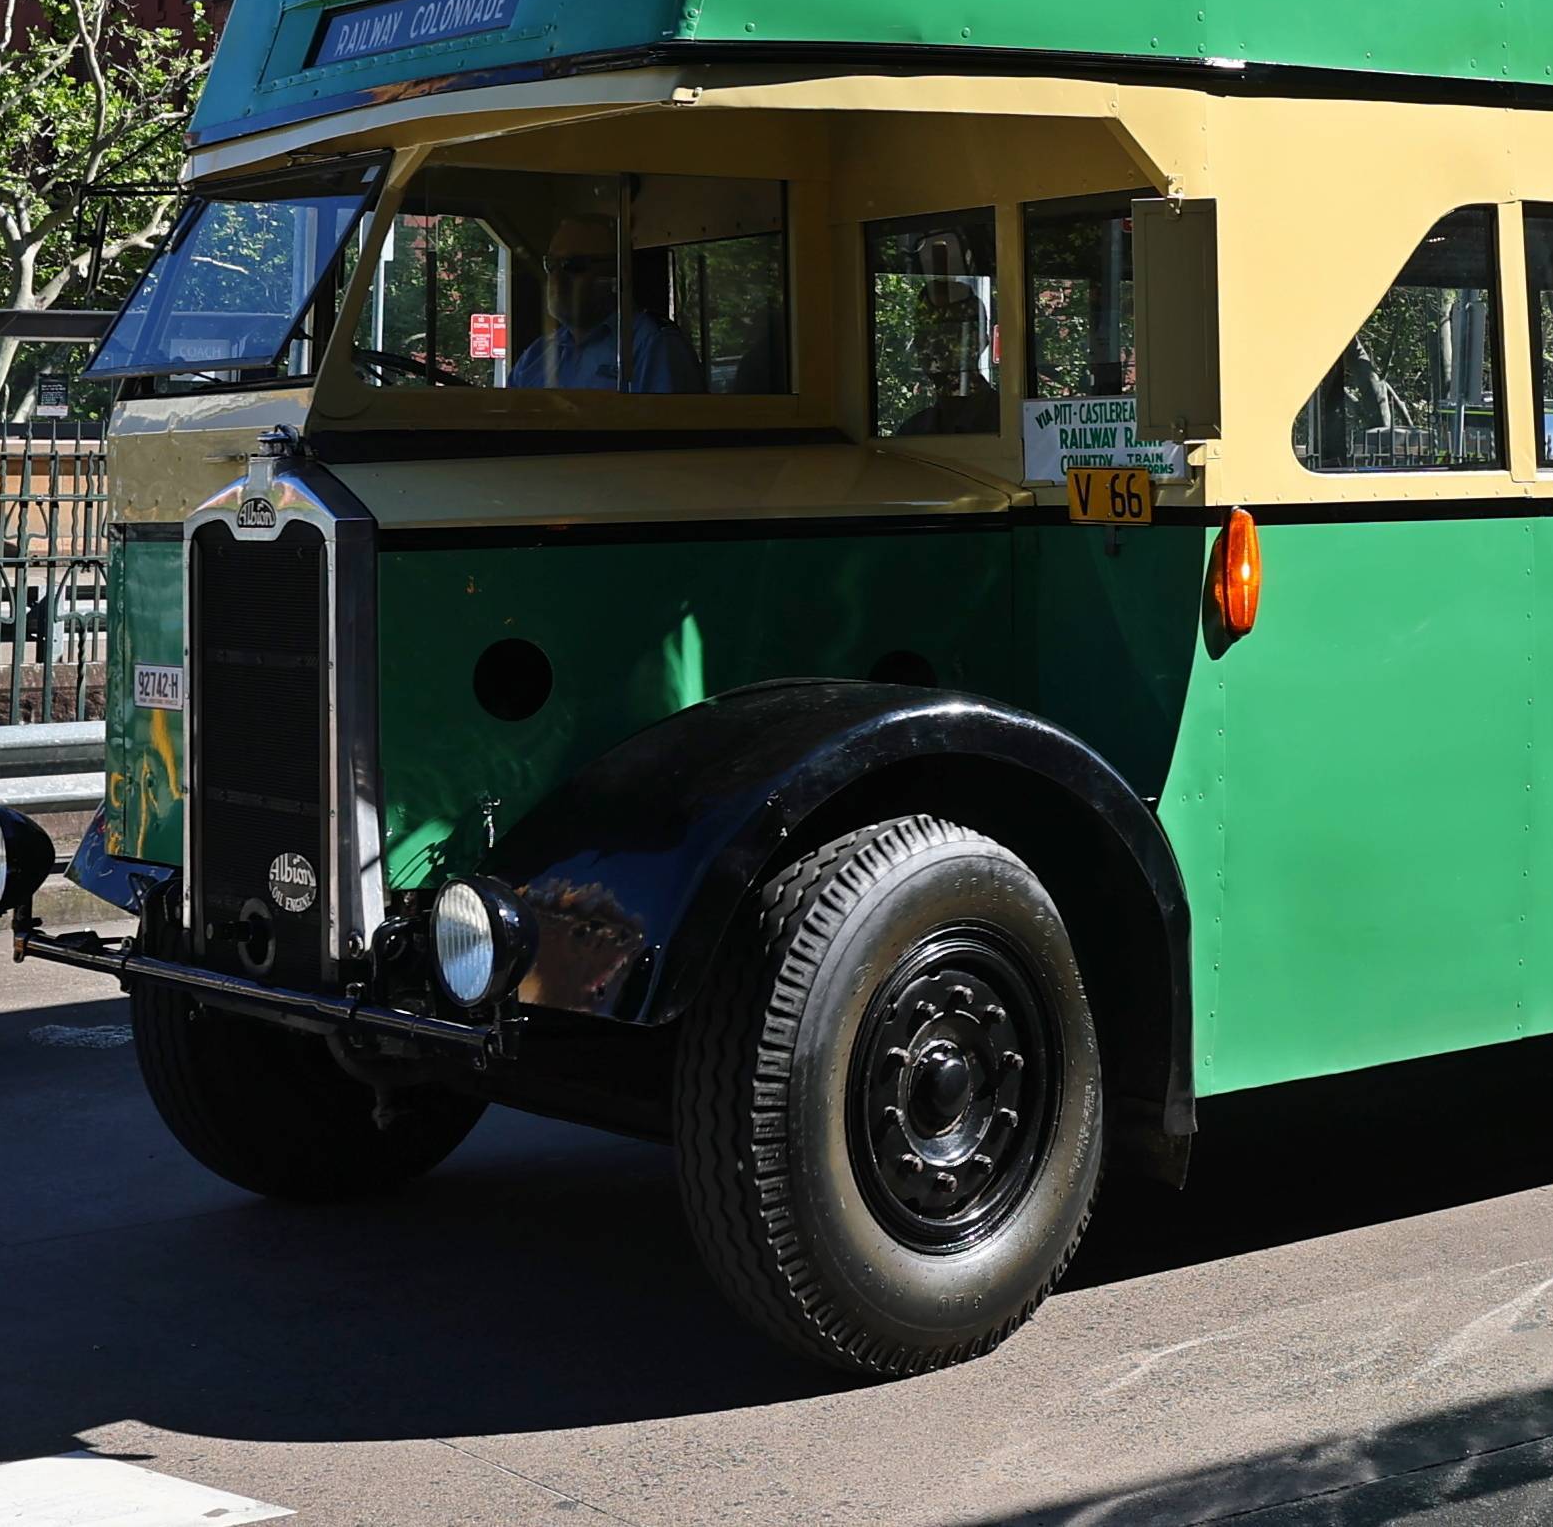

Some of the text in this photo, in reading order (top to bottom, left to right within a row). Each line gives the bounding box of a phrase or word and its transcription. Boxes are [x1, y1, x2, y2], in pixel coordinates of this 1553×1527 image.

[334, 11, 404, 57] RAILWAY
[1035, 408, 1054, 430] VIA
[1059, 427, 1118, 449] RAILWAY
[1127, 453, 1164, 463] TRAIN
[1074, 473, 1143, 518] V 66
[238, 500, 276, 526] Albion
[139, 671, 179, 699] 92742-H
[269, 853, 316, 886] Albion
[272, 886, 313, 912] OIL ENGINE
